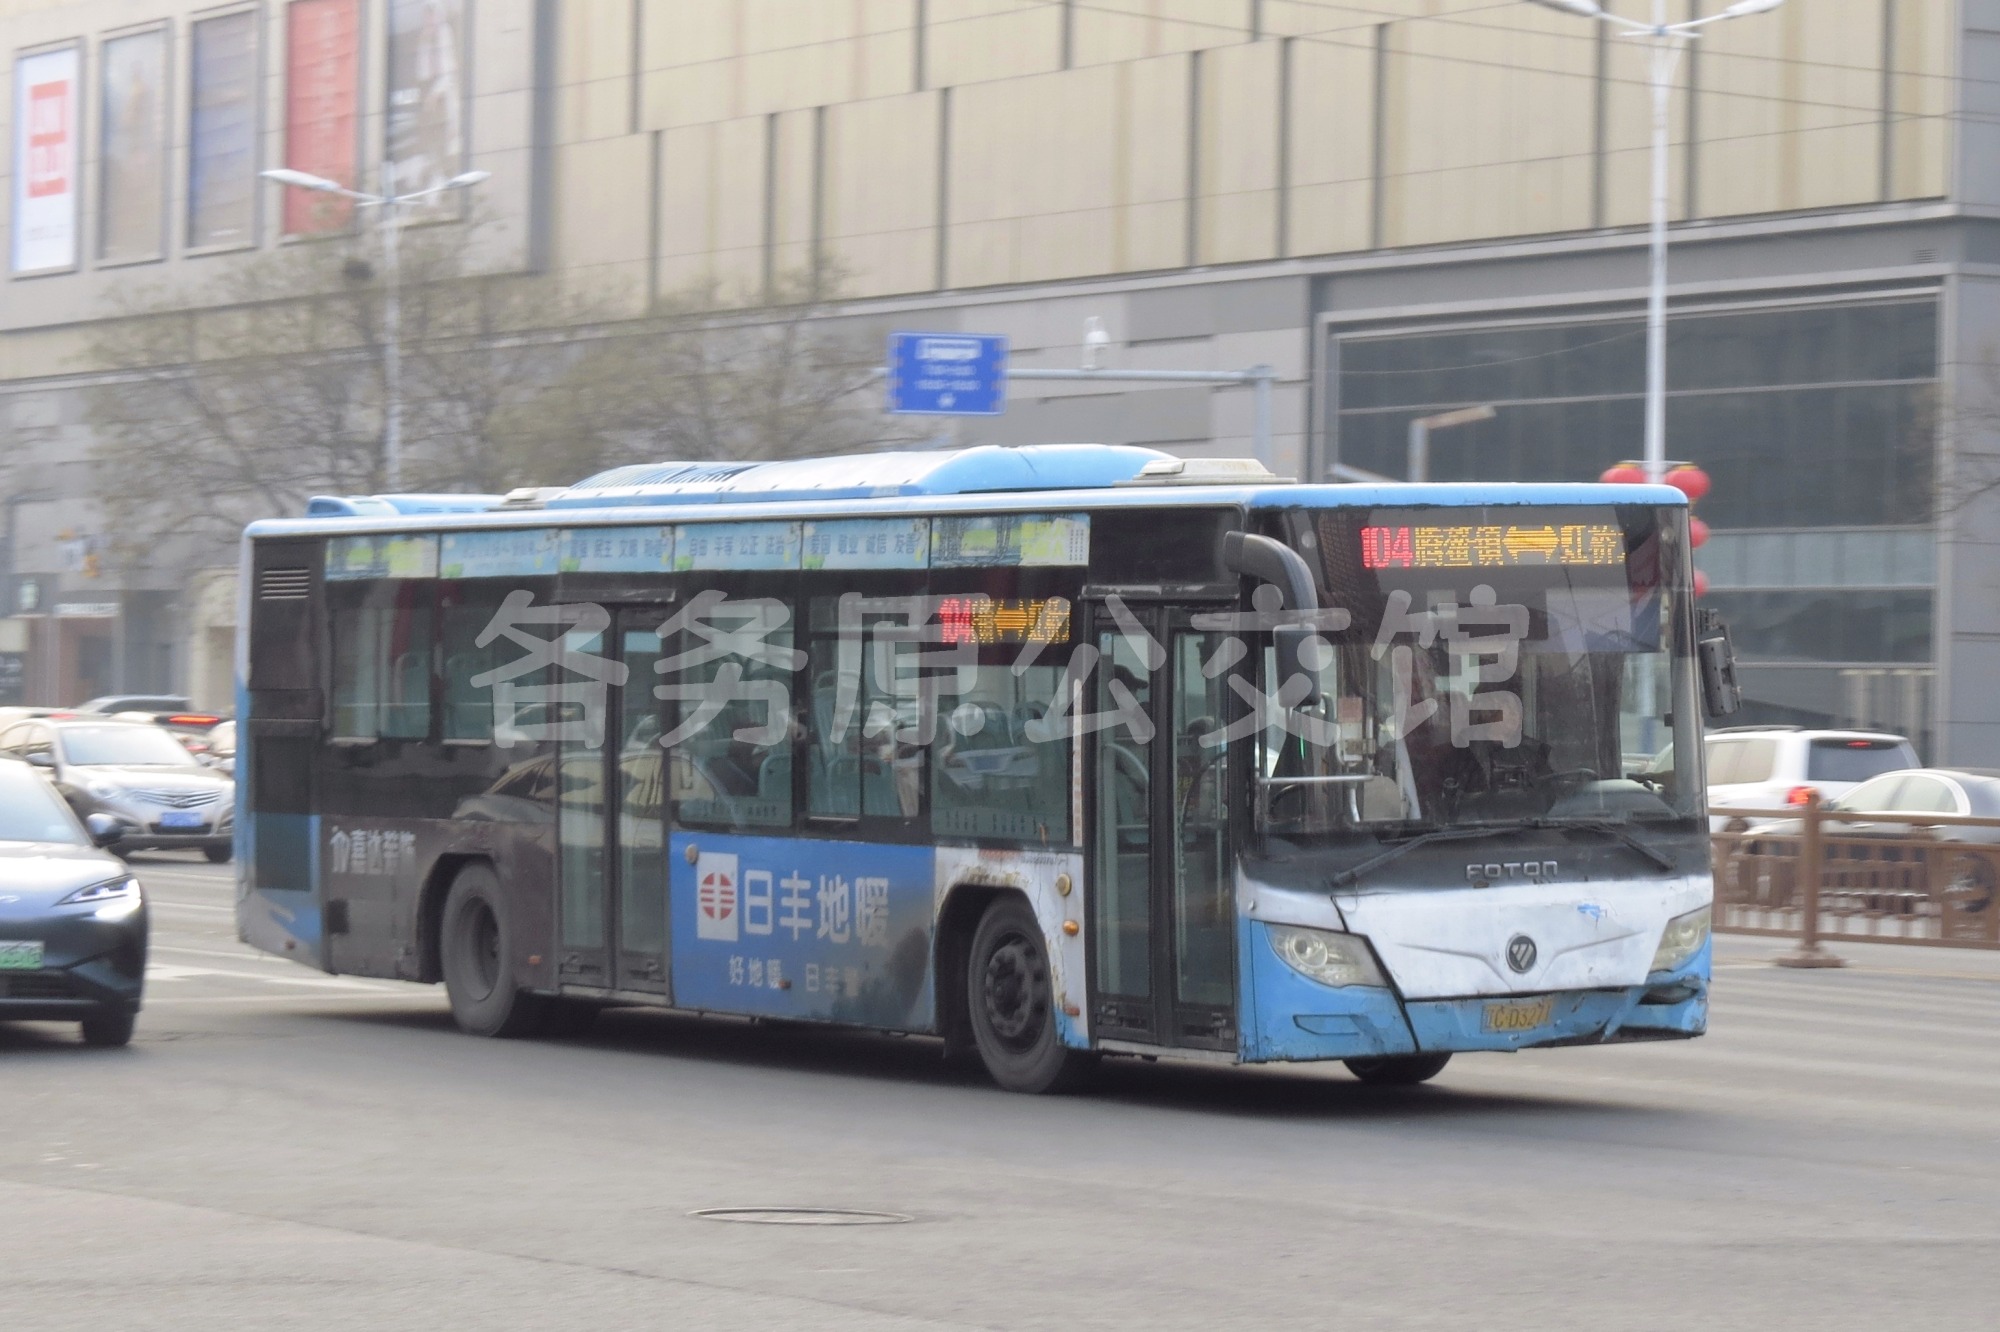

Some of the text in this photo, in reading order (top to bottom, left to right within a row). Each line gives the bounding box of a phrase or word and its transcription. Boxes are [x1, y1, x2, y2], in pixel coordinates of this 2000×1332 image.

[1361, 526, 1413, 568] 104
[1560, 525, 1626, 564] 虹桥
[939, 600, 972, 643] 104
[1466, 860, 1558, 880] FOTON
[744, 869, 889, 946] 日丰地暖
[806, 963, 859, 997] 日丰
